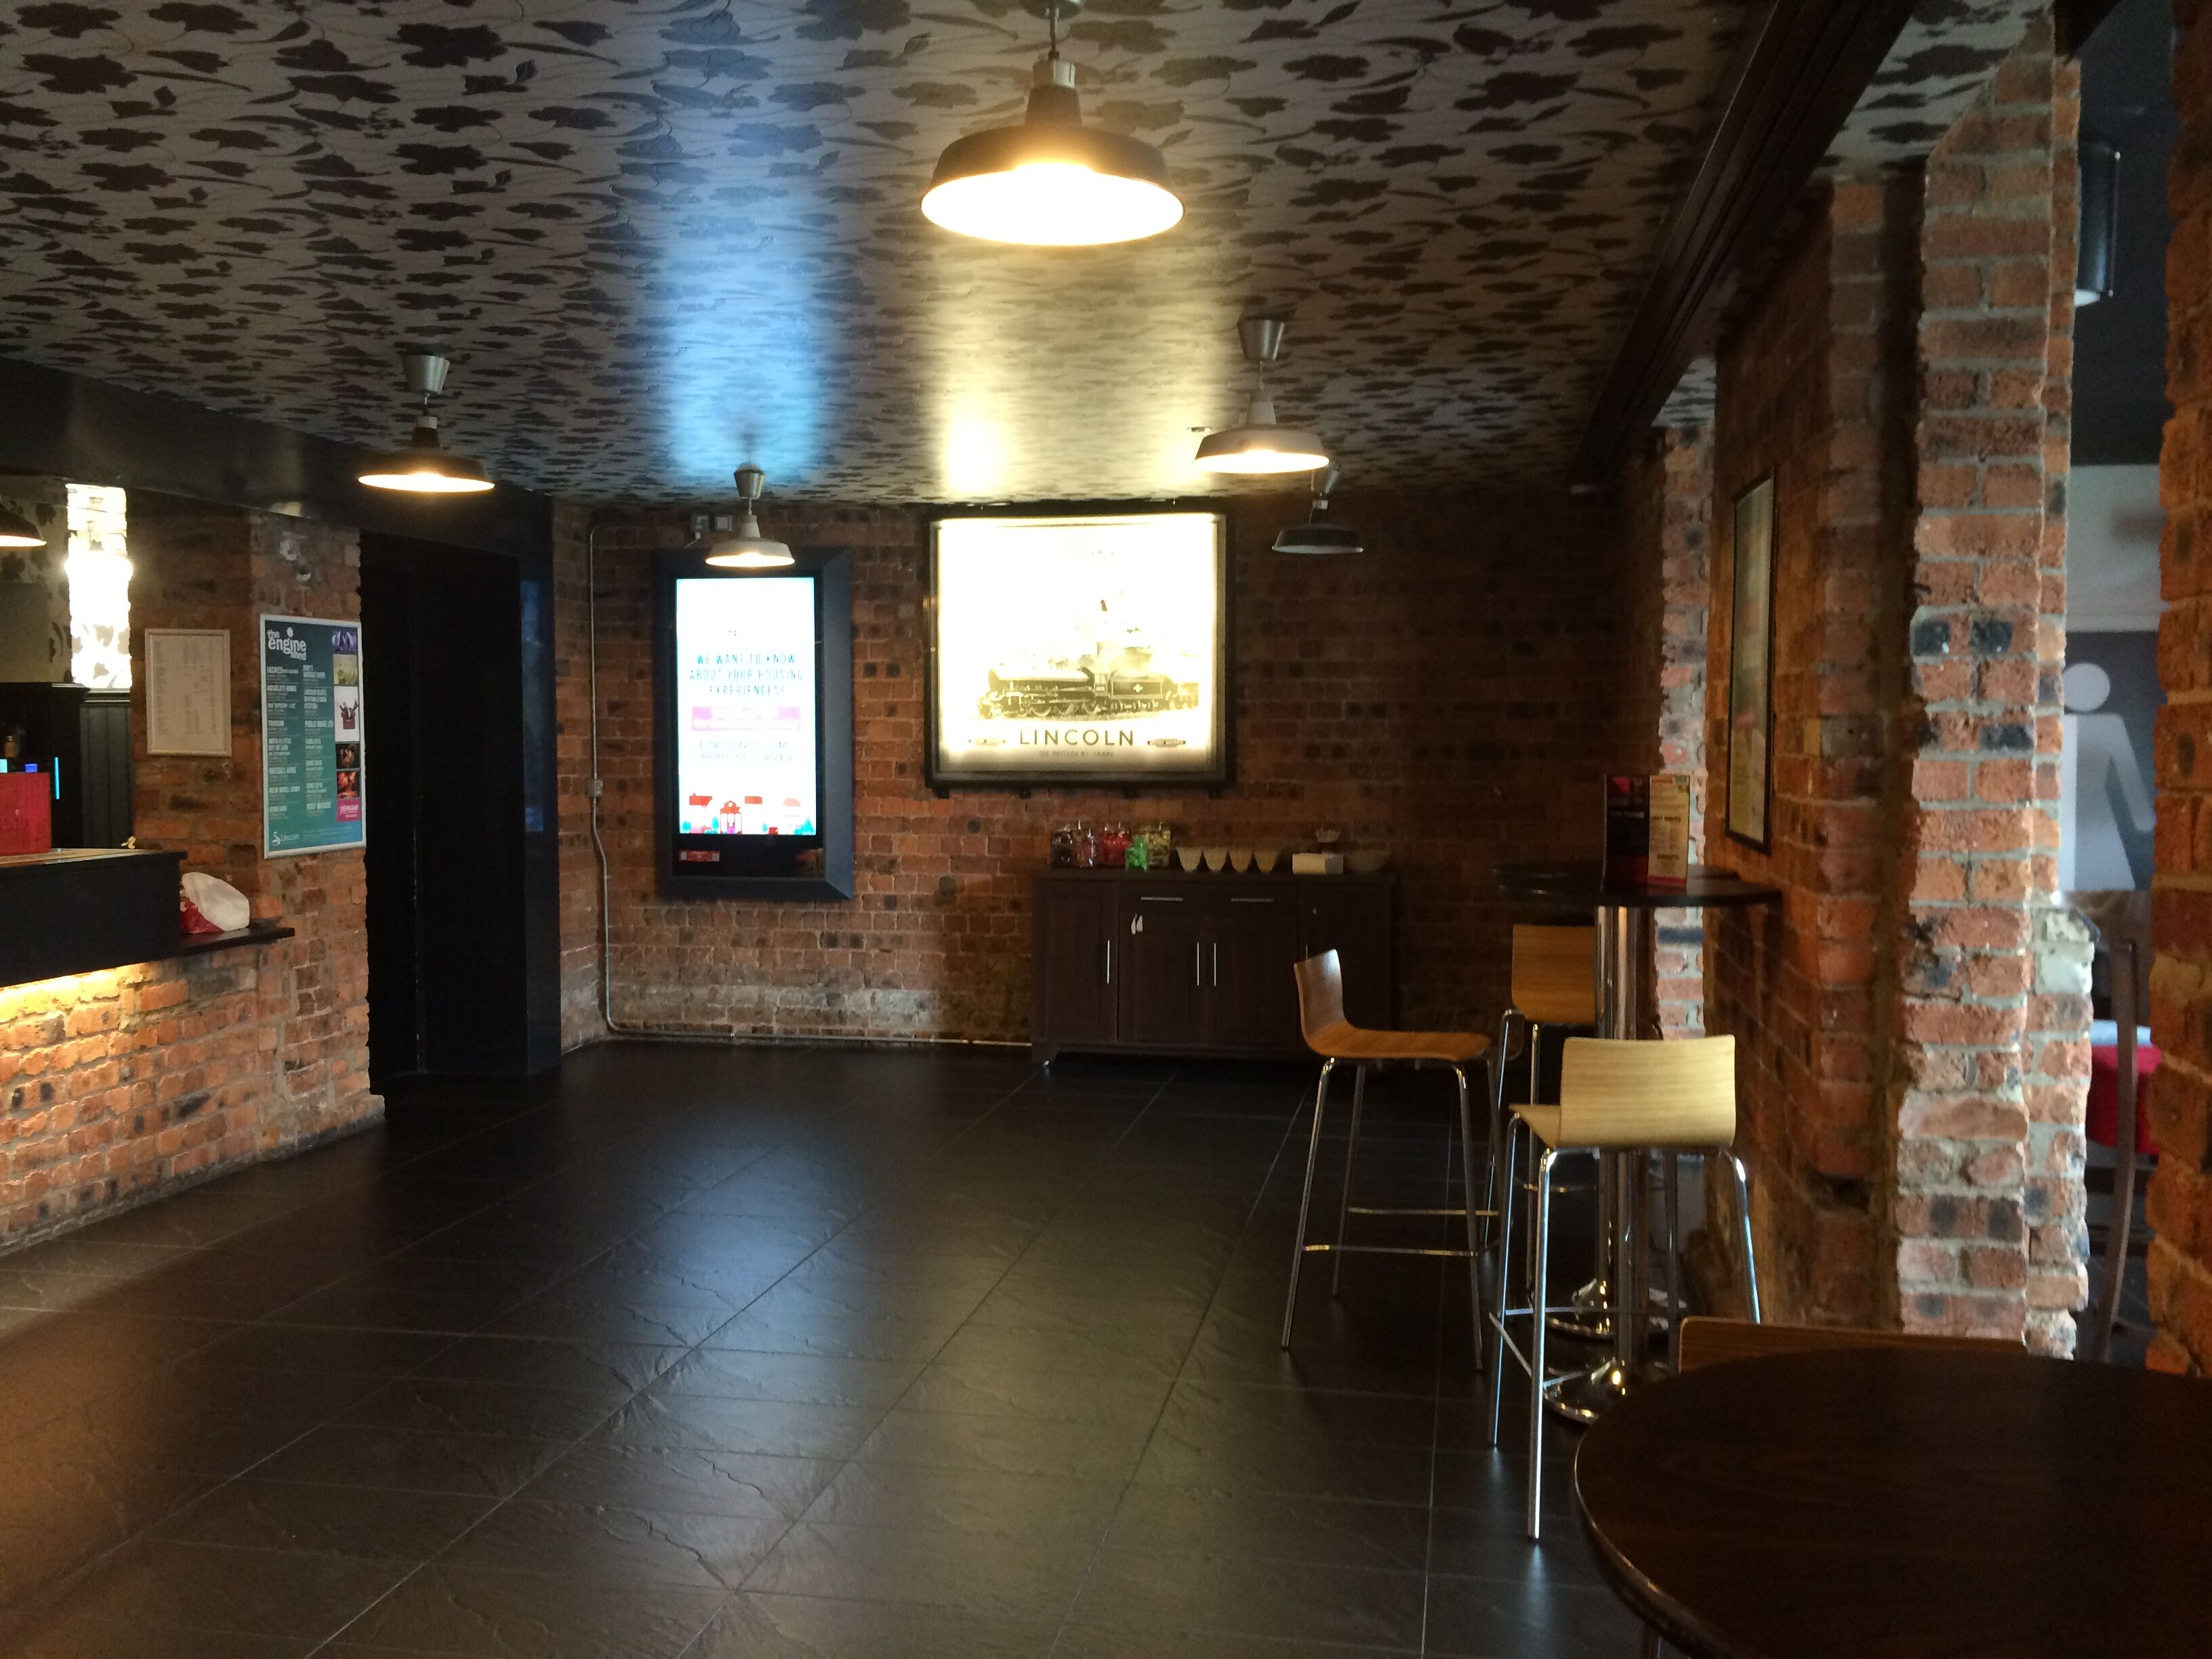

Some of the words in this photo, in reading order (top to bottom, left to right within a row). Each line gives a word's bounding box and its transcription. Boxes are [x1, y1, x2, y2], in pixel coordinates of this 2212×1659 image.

[267, 629, 280, 639] the
[268, 638, 307, 655] engine
[290, 651, 307, 661] shed
[697, 653, 710, 665] WE
[716, 653, 743, 665] WANT
[749, 653, 761, 665] TO
[766, 653, 796, 665] KNOW
[1020, 730, 1134, 746] LINCOLN
